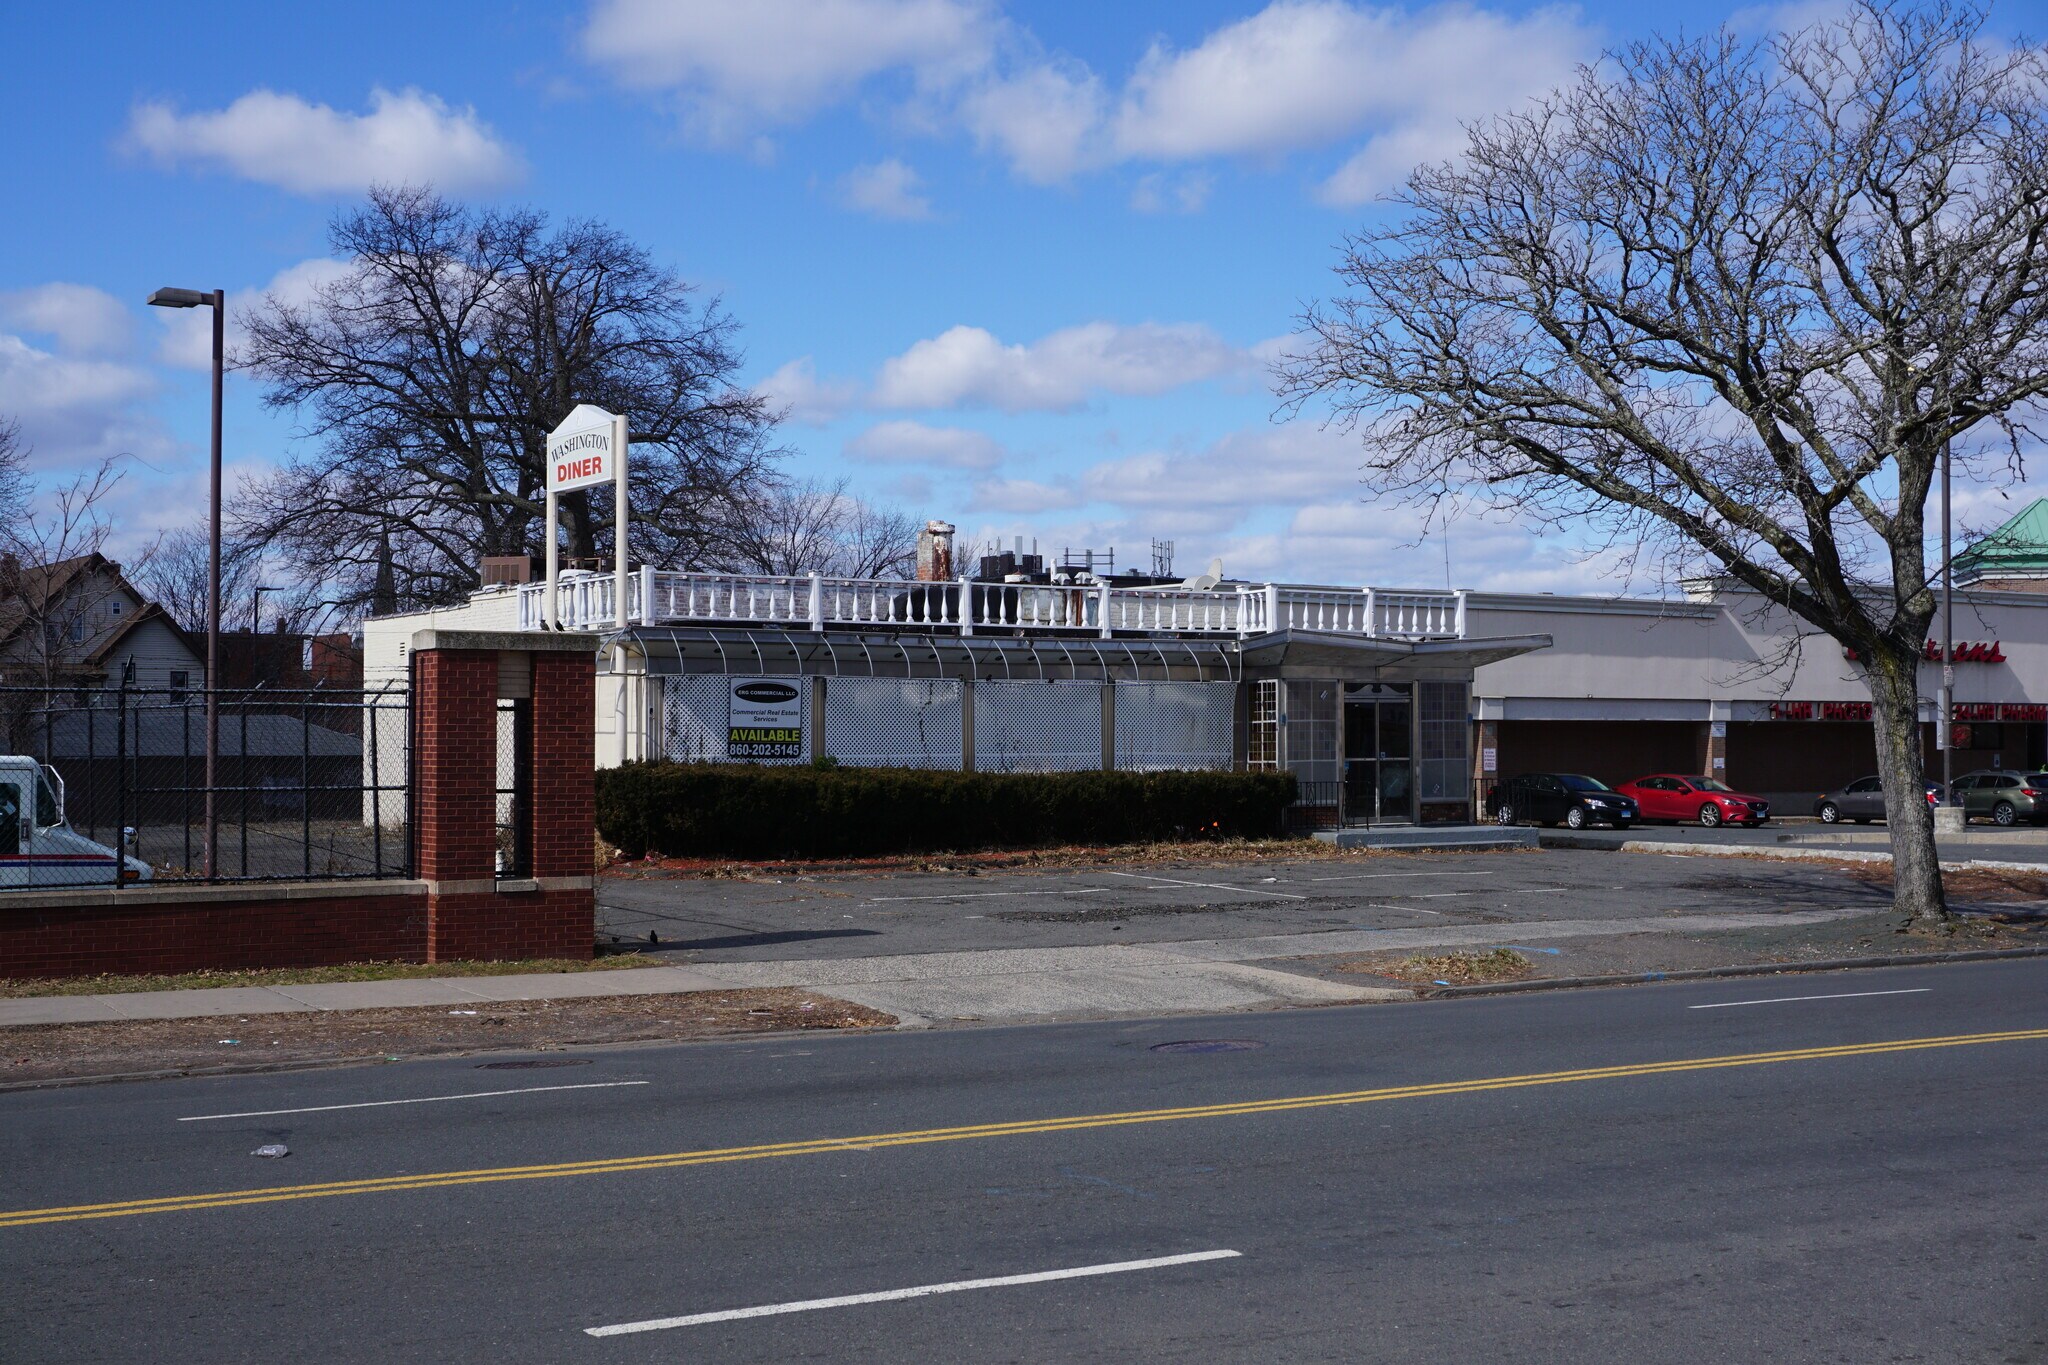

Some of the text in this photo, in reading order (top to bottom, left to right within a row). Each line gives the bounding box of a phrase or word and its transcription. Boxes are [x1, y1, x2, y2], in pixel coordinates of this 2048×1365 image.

[551, 434, 609, 462] WASHINGTON
[557, 456, 602, 482] DINER
[1818, 703, 1873, 720] PHOTO
[731, 729, 800, 742] AVAILABLE
[729, 743, 799, 756] 860-202-5145
